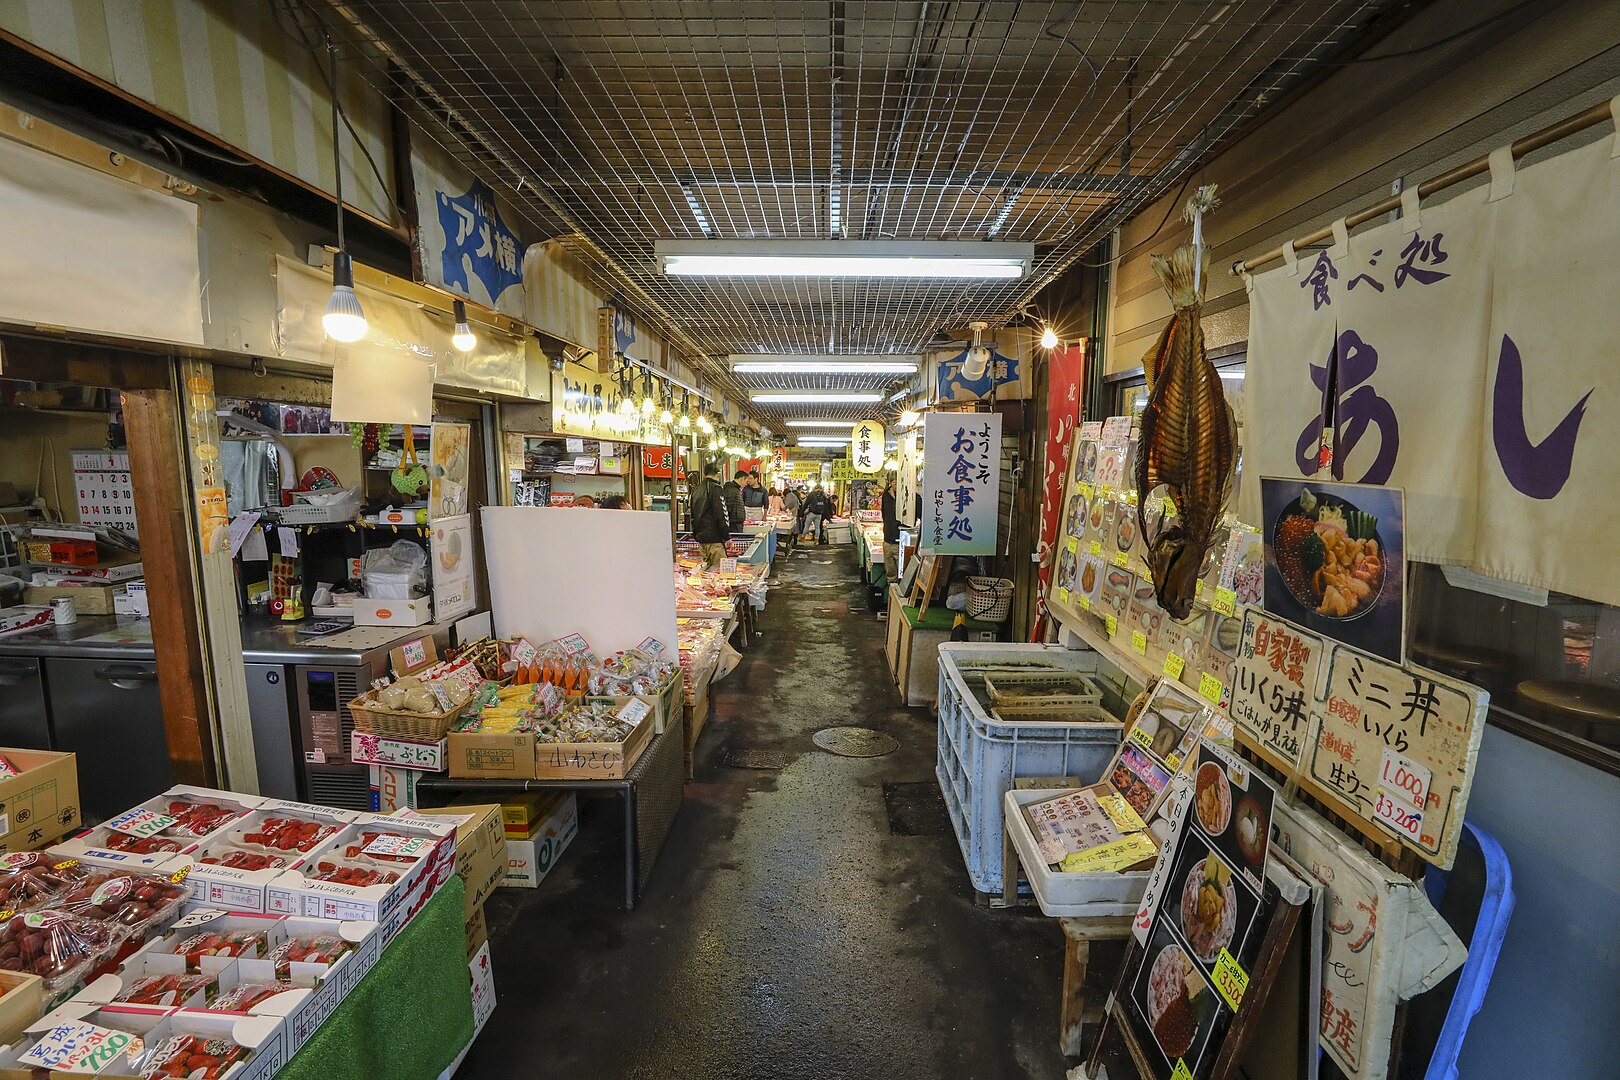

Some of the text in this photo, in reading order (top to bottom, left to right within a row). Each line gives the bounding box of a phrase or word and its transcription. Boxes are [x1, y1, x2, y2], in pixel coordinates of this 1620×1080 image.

[451, 203, 517, 276] アメ横
[1300, 231, 1452, 311] 食べ処
[946, 360, 1008, 381] ア横
[858, 425, 872, 468] 食事処
[976, 422, 991, 485] ようこそ
[947, 427, 977, 542] お食事処
[933, 490, 944, 546] はやしや食堂
[1243, 618, 1256, 660] 新物
[1255, 619, 1310, 689] 自家製
[1241, 666, 1307, 731] いくら丼
[1328, 696, 1361, 729] 自家製
[1363, 714, 1409, 753] いくら
[400, 747, 436, 766] ぶどう
[384, 770, 397, 811] メロン
[1328, 762, 1374, 807] 生ウニ
[28, 829, 42, 843] 本
[135, 817, 175, 836] 1960
[400, 838, 424, 853] 980
[29, 1023, 76, 1058] 宮城
[80, 1034, 129, 1074] 780
